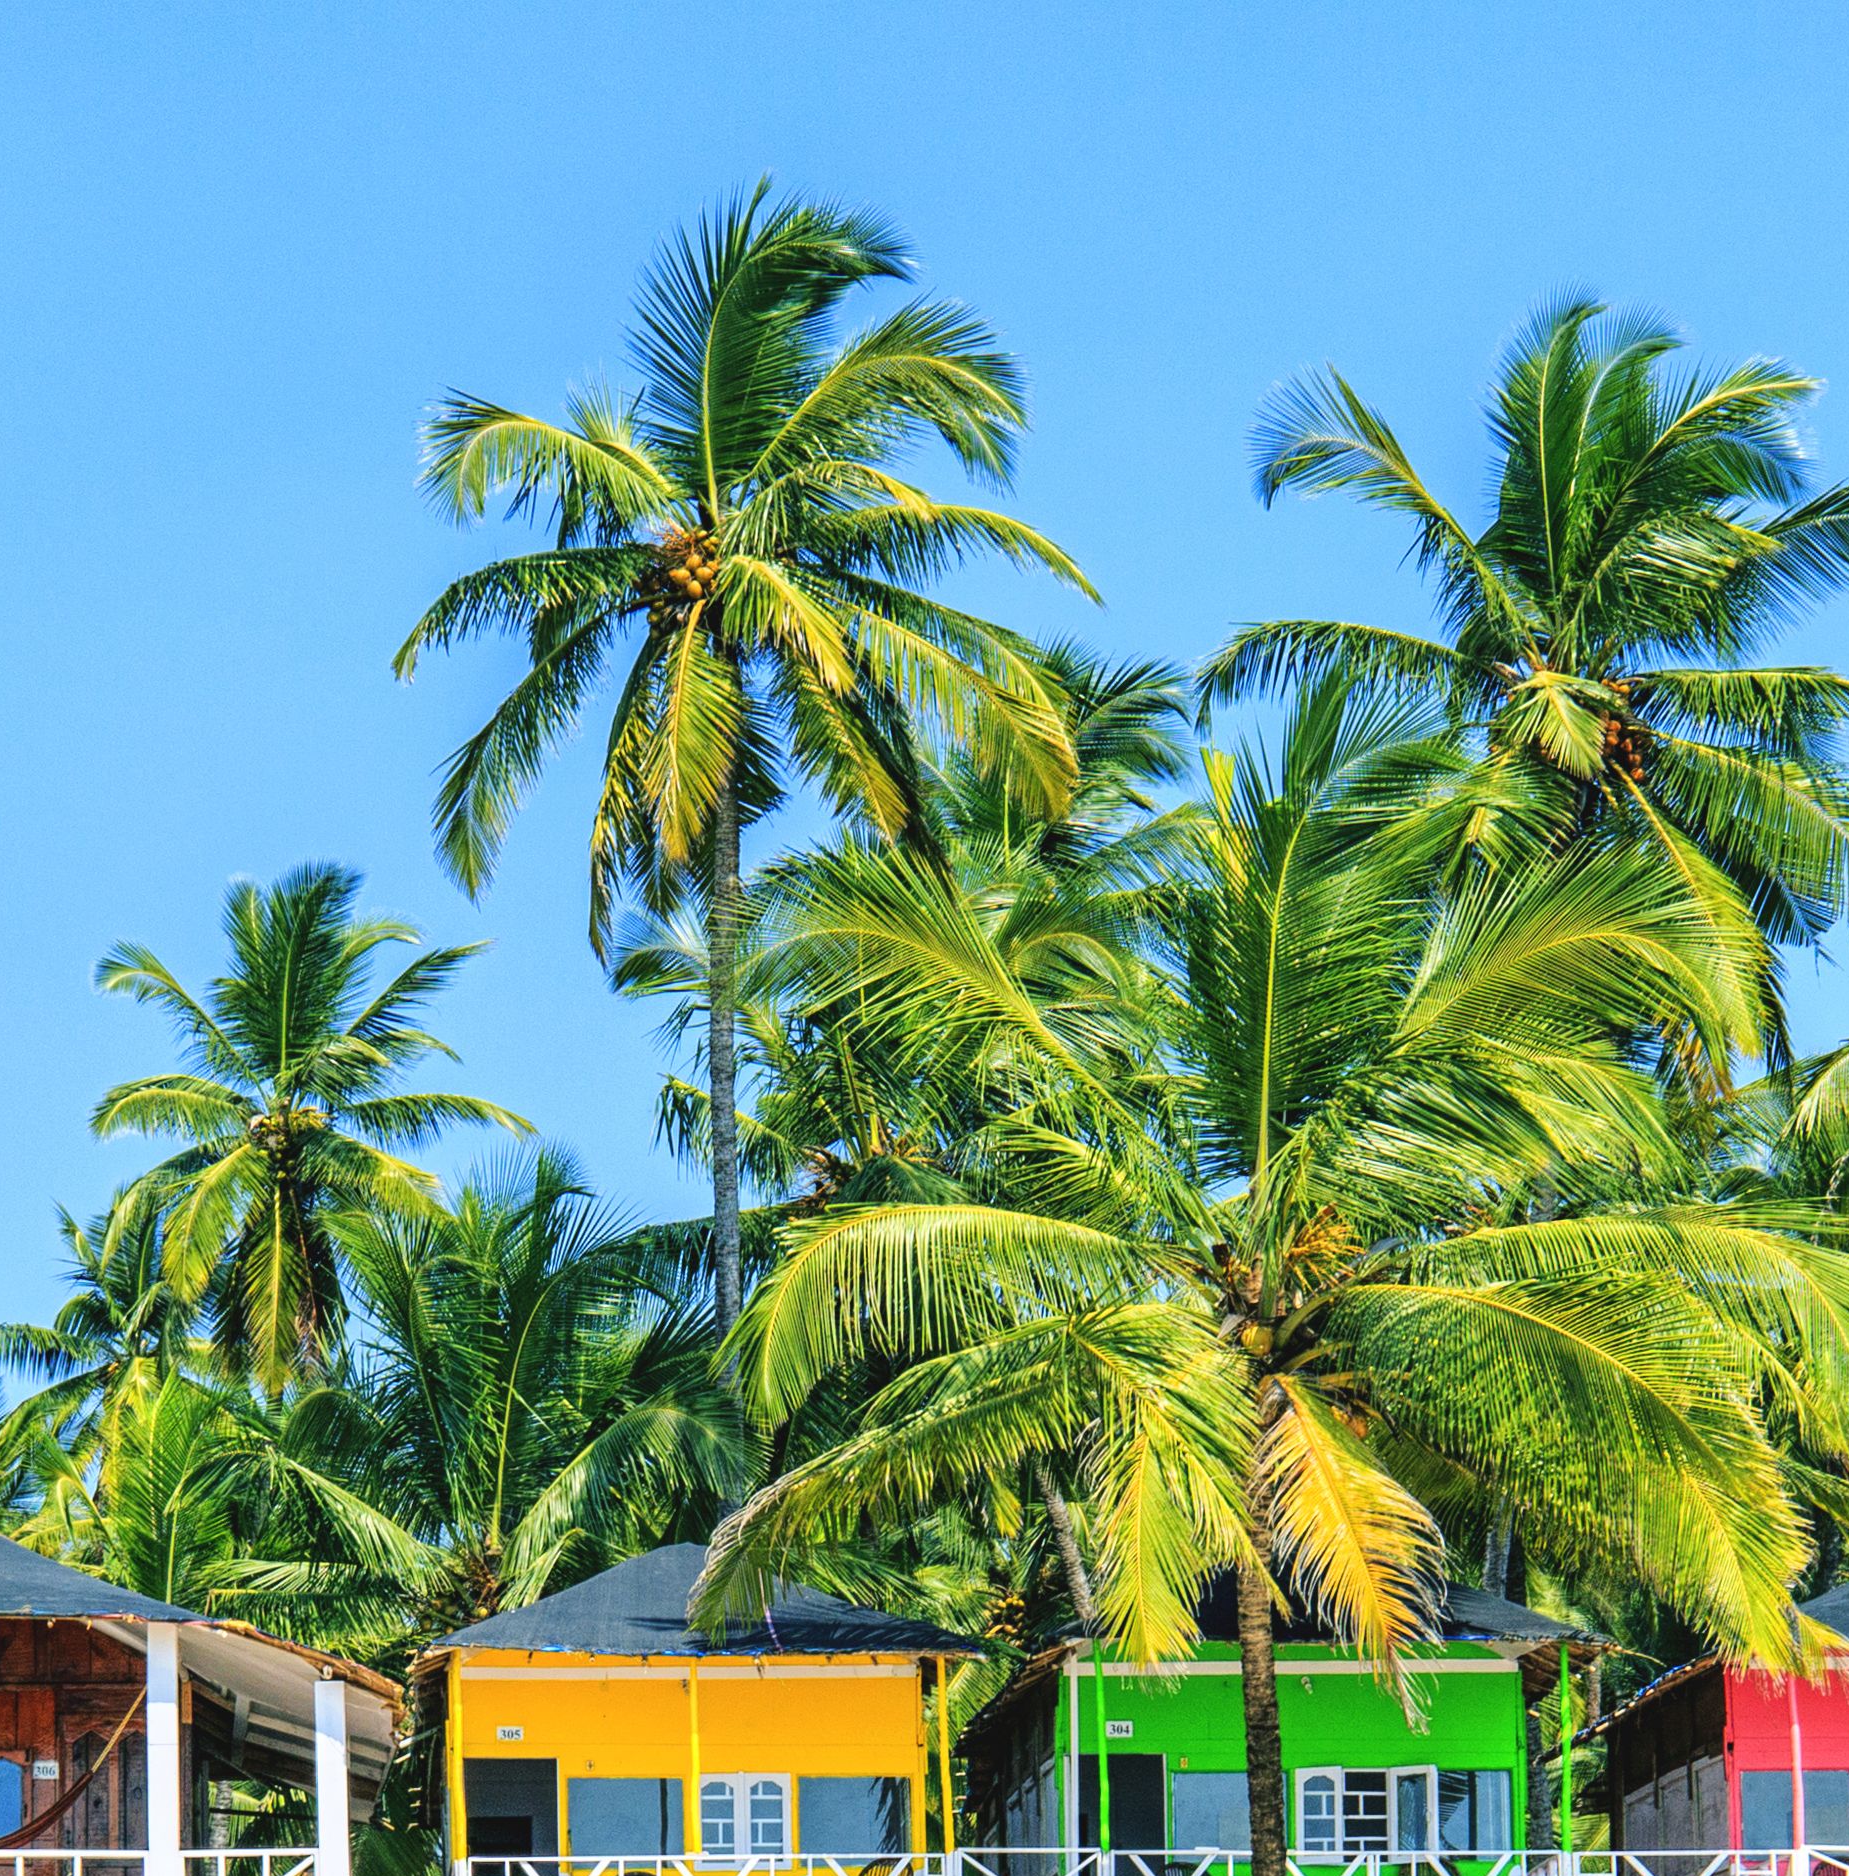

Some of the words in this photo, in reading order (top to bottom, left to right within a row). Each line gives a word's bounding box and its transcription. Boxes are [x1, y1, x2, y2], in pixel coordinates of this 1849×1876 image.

[500, 1729, 521, 1740] 305
[1109, 1724, 1130, 1735] 304
[34, 1765, 56, 1777] 306
